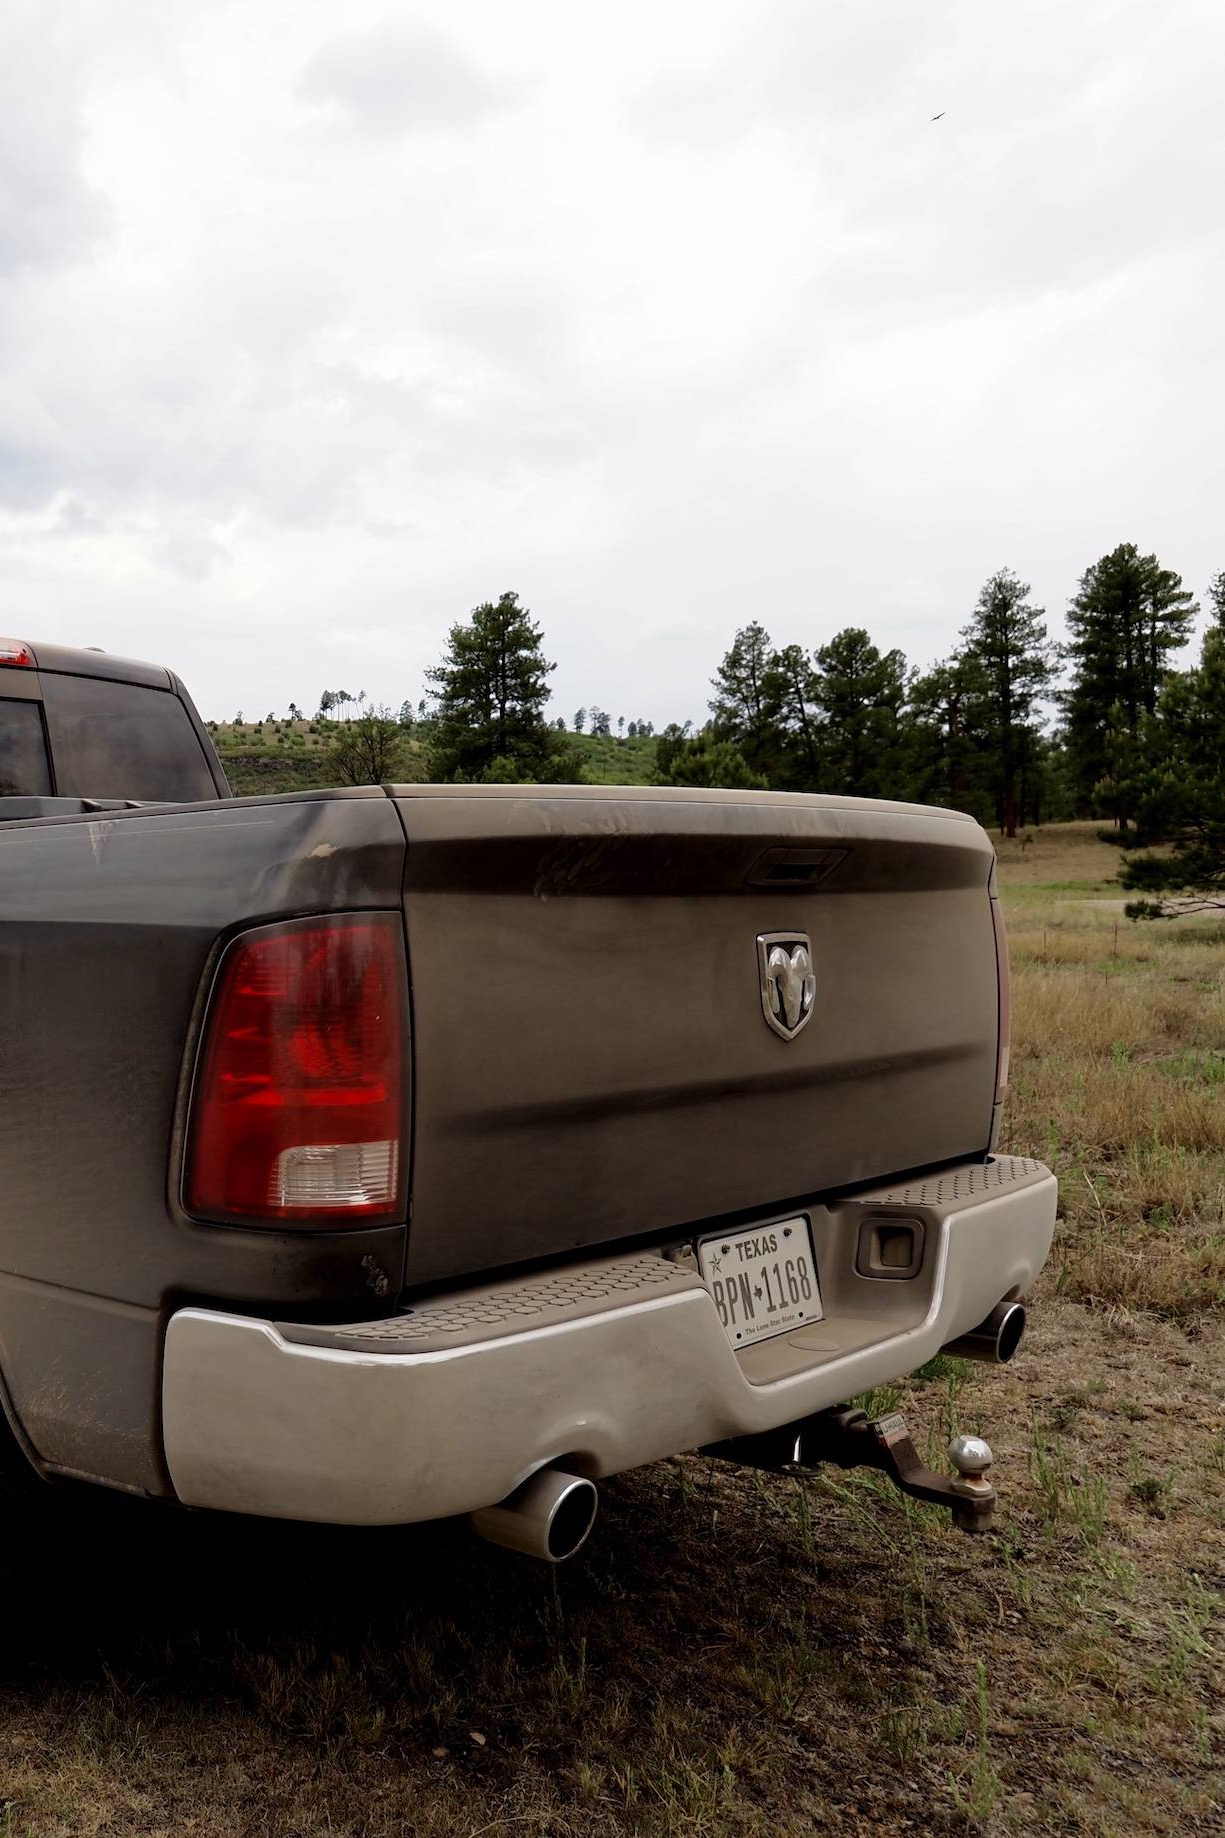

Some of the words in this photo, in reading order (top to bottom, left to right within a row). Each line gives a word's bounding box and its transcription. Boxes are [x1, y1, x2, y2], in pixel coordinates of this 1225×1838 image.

[735, 1234, 778, 1262] TEXAS
[761, 1256, 812, 1313] 1168
[745, 1327, 756, 1335] The
[756, 1323, 769, 1332] Lone
[769, 1319, 781, 1327] Star
[781, 1314, 795, 1323] State
